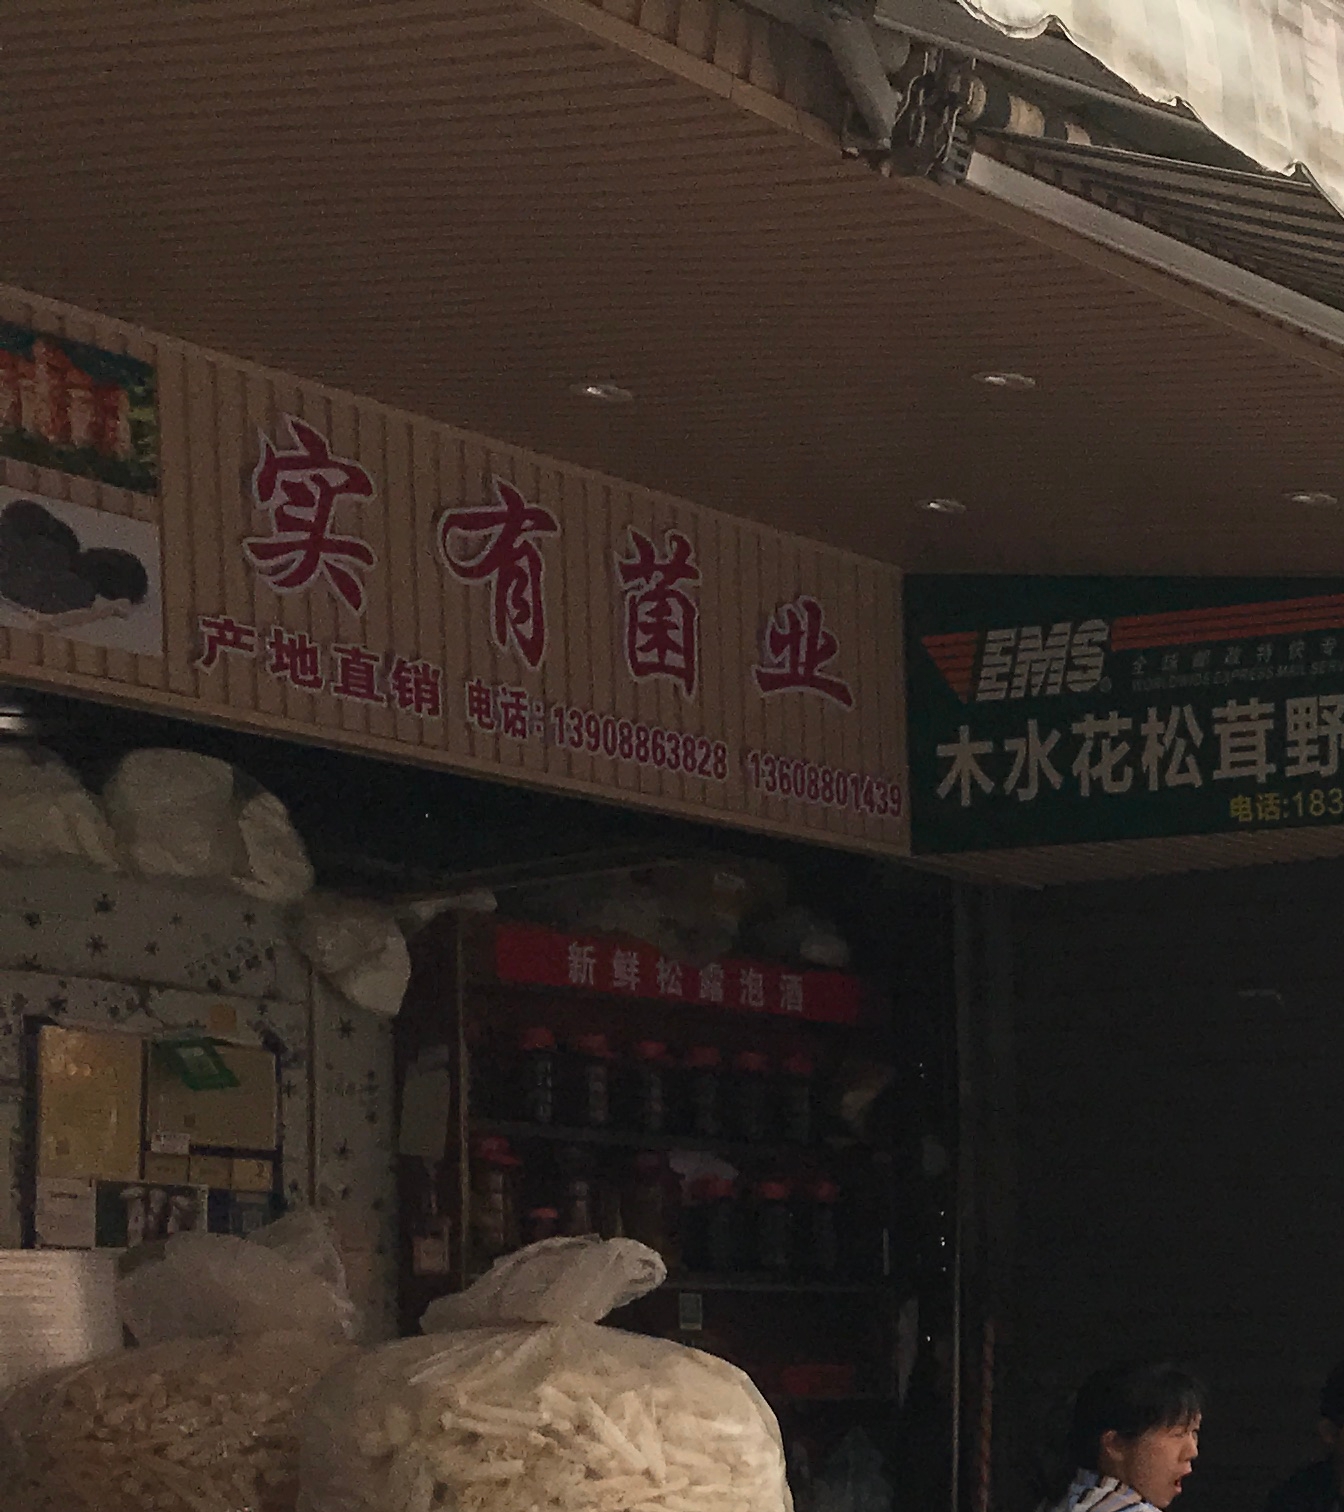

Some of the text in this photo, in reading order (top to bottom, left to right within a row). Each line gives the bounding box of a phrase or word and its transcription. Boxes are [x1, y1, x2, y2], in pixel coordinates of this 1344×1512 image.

[243, 412, 856, 708] 实有菌业
[976, 618, 1110, 701] EMS
[194, 615, 445, 718] 产地直销
[746, 748, 904, 818] 13608801439
